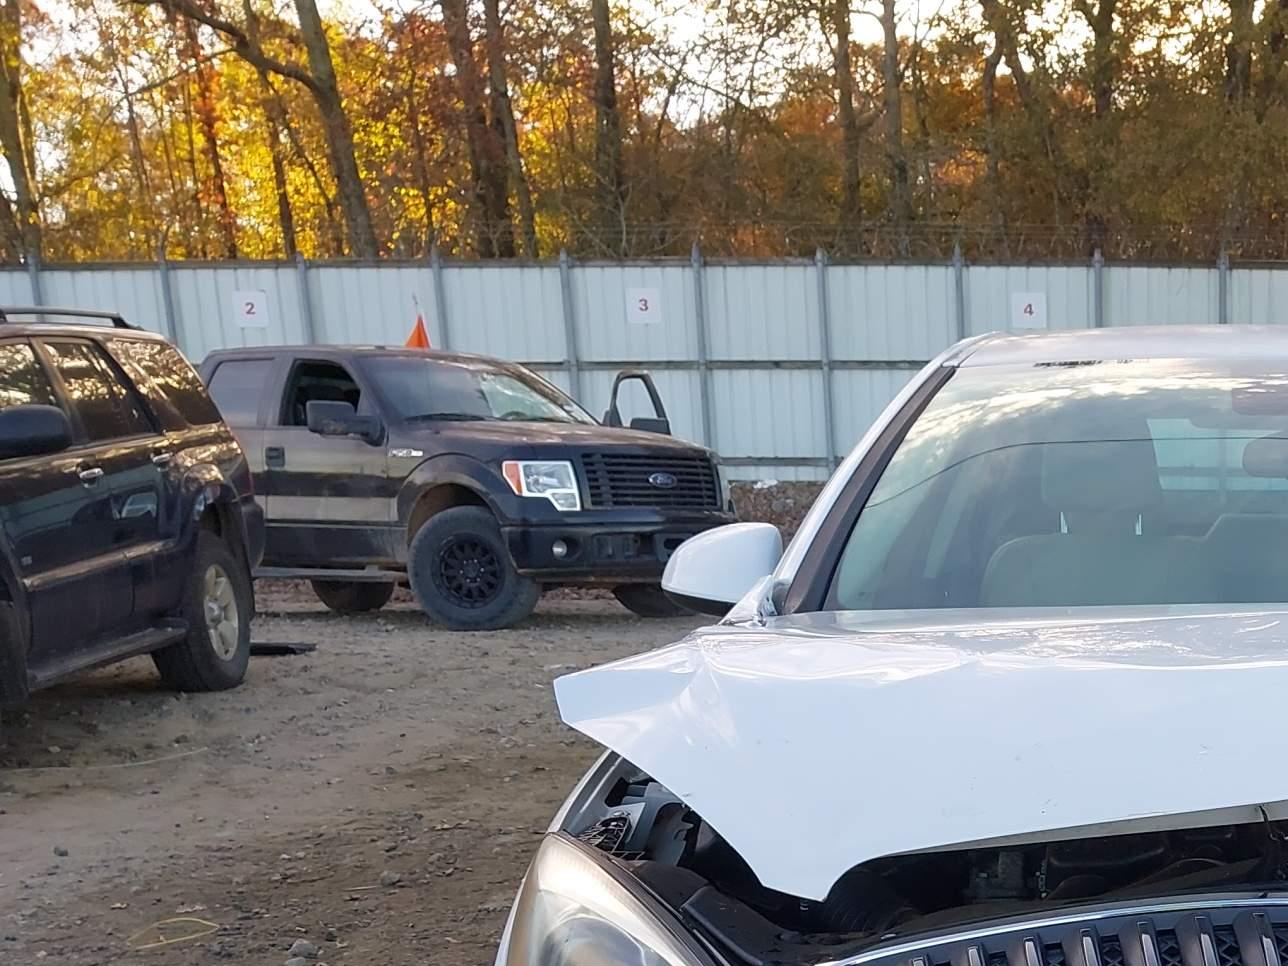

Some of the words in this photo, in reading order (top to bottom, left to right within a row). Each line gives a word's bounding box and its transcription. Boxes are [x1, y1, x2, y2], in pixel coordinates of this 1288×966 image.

[245, 302, 256, 315] 2
[638, 298, 649, 312] 3
[1023, 303, 1034, 316] 4
